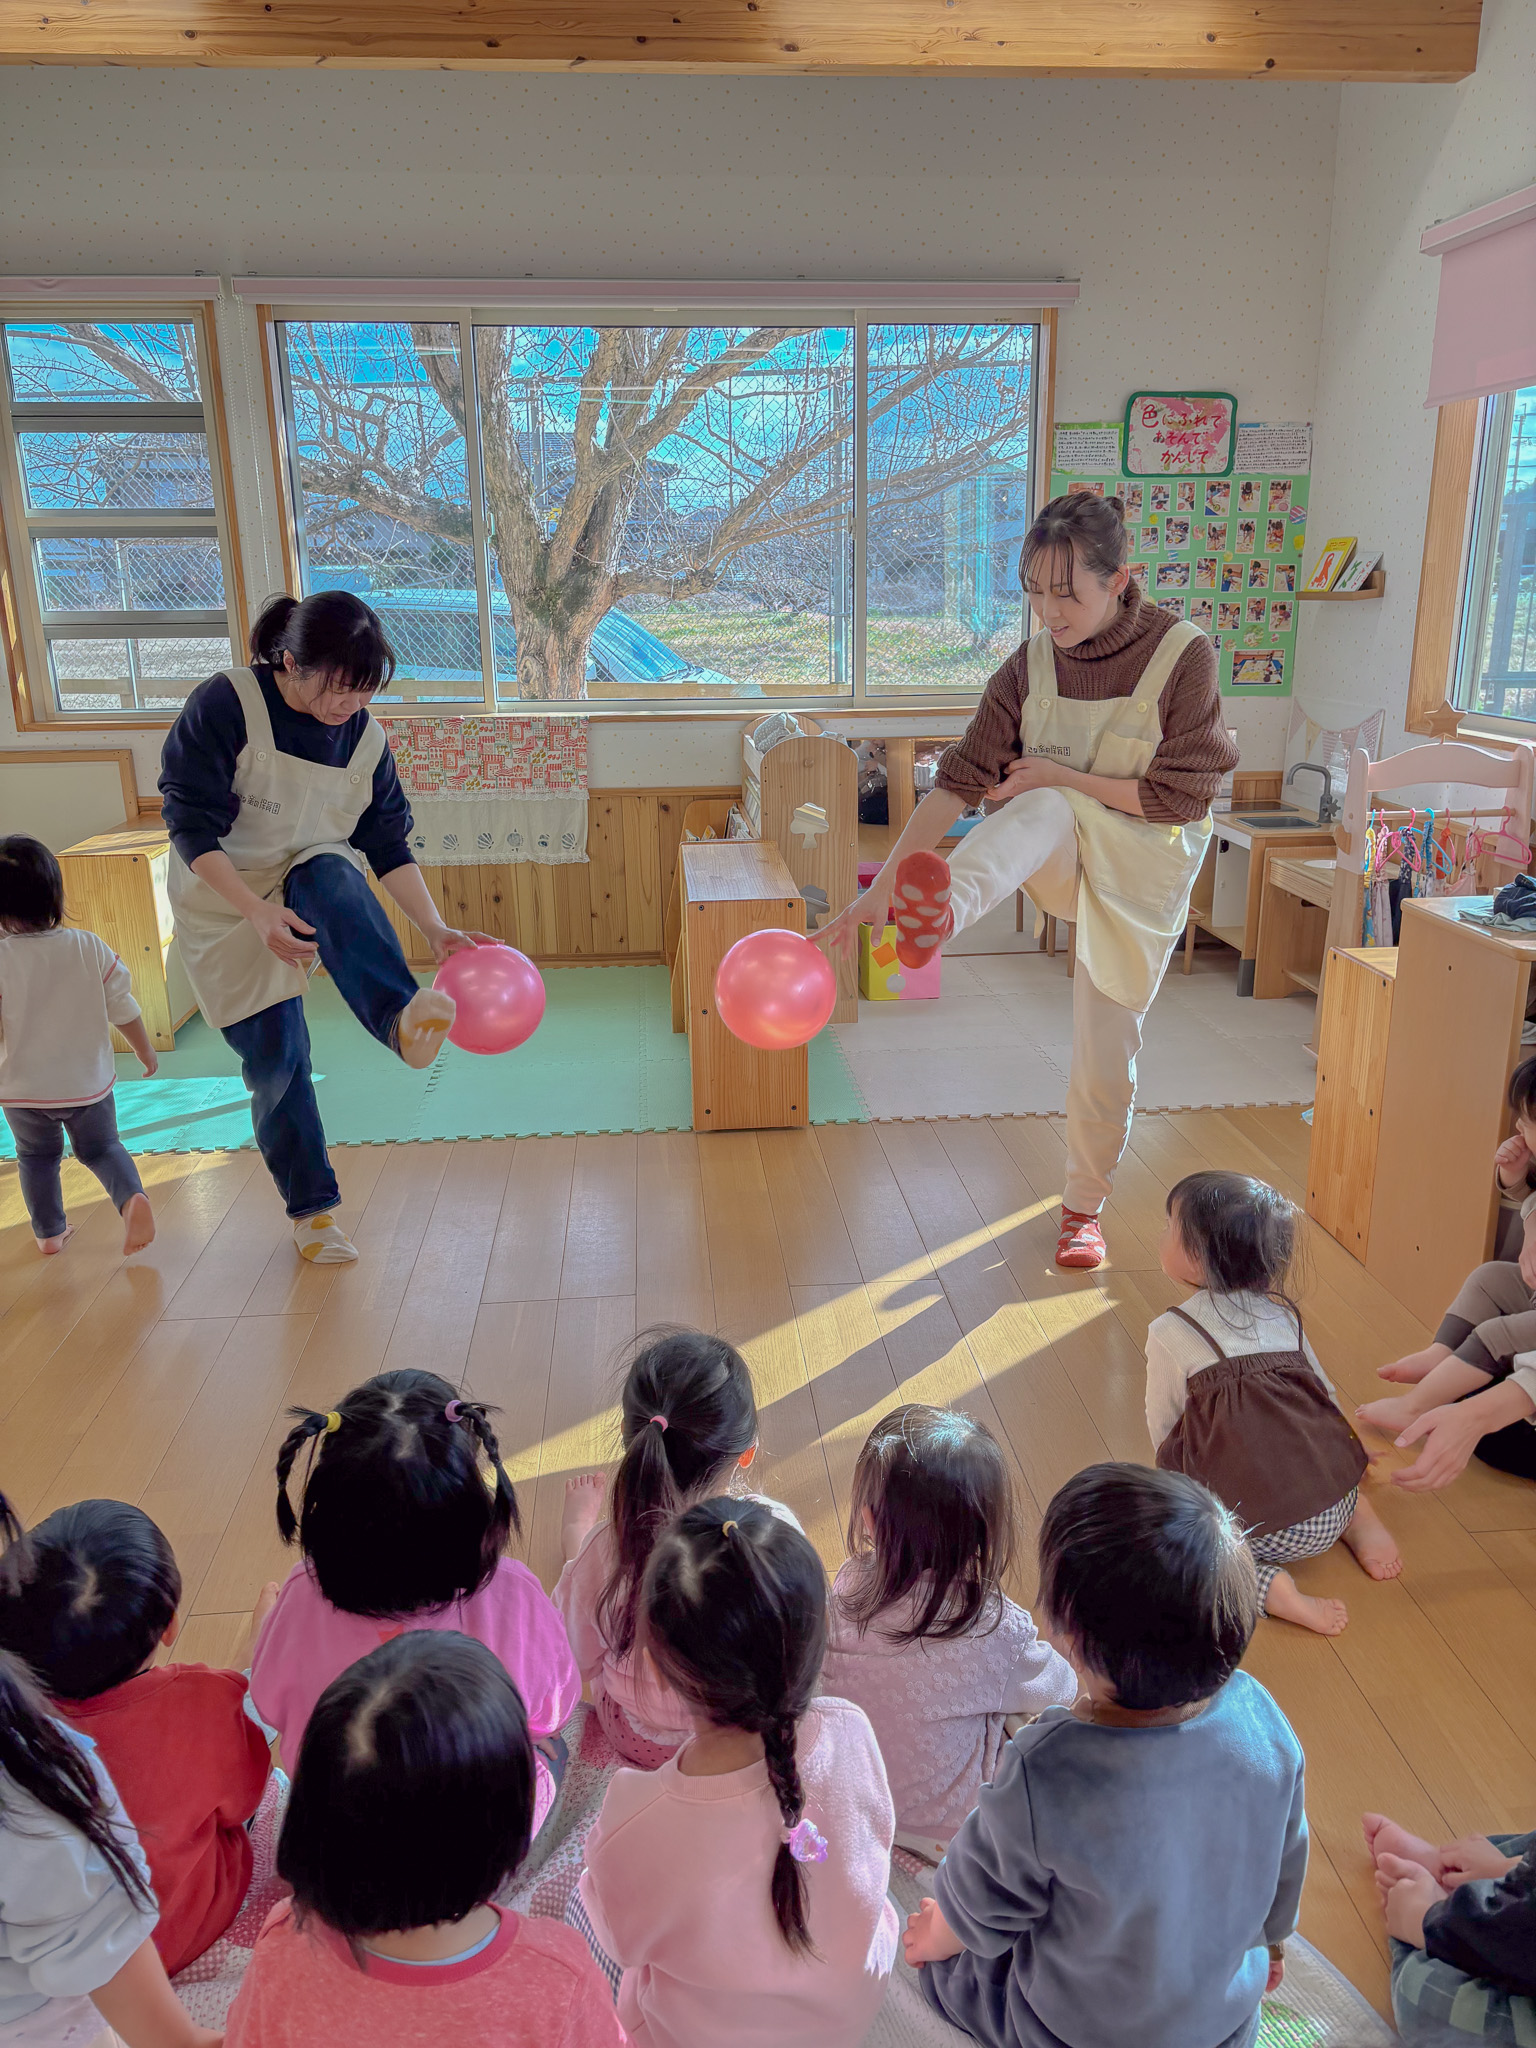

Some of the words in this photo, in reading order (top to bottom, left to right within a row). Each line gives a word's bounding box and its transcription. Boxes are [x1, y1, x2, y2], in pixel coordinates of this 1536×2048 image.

[1141, 403, 1222, 428] 色にふれて
[1152, 430, 1209, 445] あそんで
[1160, 449, 1209, 464] かんして
